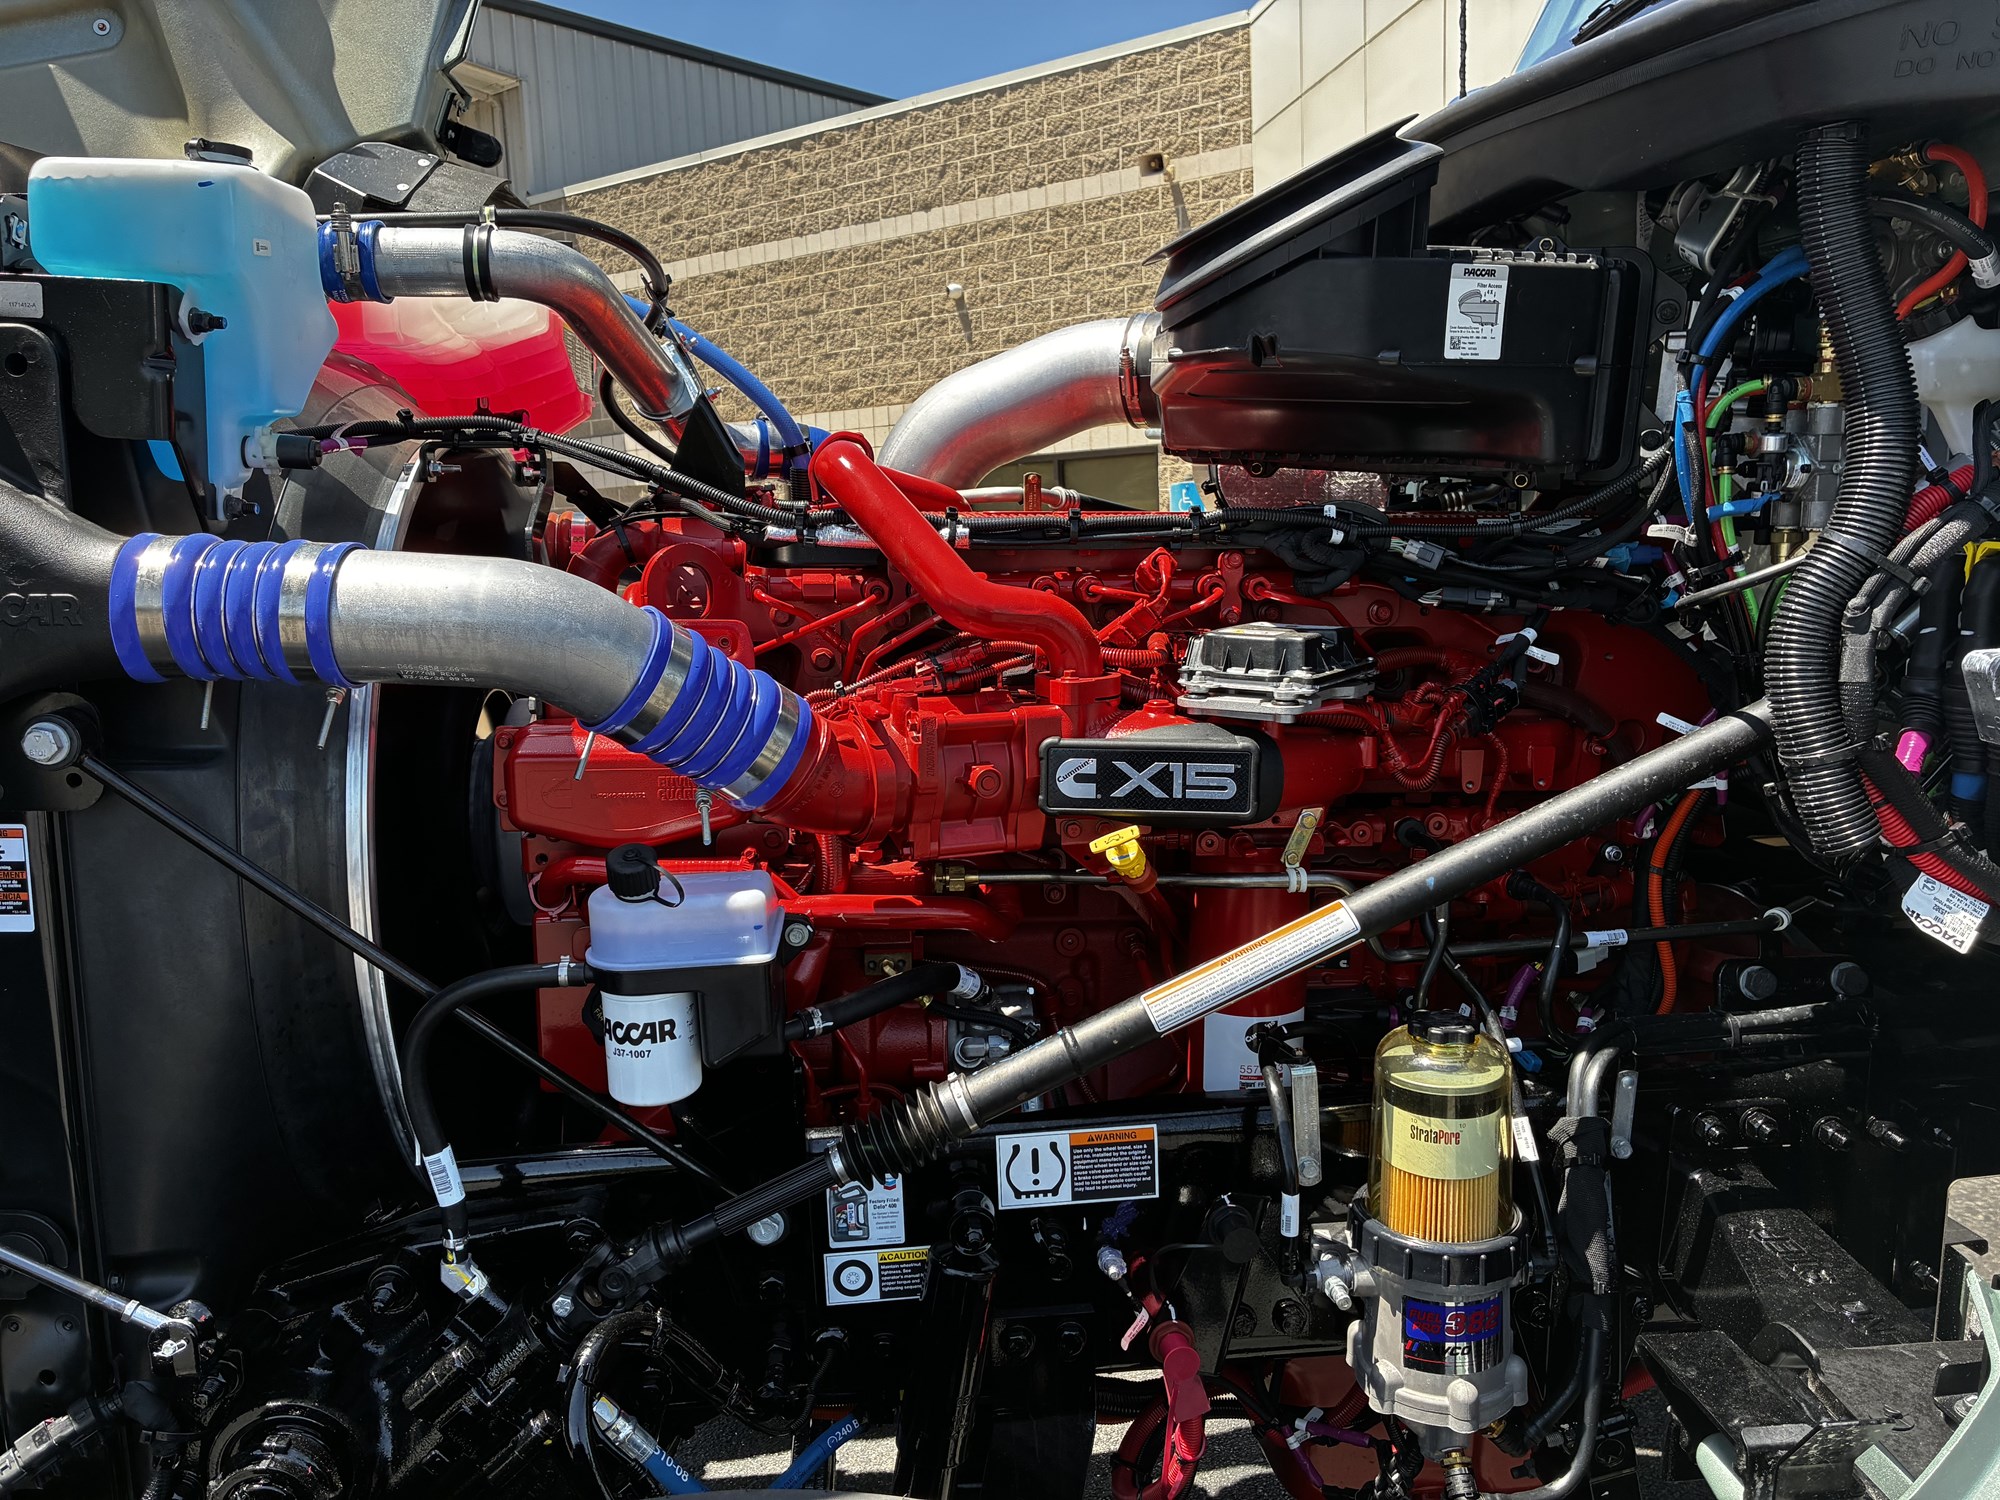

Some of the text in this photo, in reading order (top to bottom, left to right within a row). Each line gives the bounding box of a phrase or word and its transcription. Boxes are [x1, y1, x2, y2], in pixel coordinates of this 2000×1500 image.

[1899, 20, 1960, 50] NO
[1894, 49, 2000, 78] DO NO
[1464, 268, 1496, 278] PACCAR
[1057, 758, 1237, 800] Cummins X15
[1902, 905, 1965, 949] PACCAR
[1224, 938, 1268, 964] WARNING
[604, 1017, 677, 1046] ACCAR
[613, 1047, 652, 1058] J37-1007
[1096, 1131, 1137, 1142] WARNING
[1410, 1124, 1460, 1146] StrataPore
[1098, 1155, 1131, 1163] manufacturer.
[887, 1250, 928, 1260] CAUTION
[1409, 1304, 1500, 1337] FUEL 382
[1412, 1322, 1440, 1335] PRO
[834, 1423, 852, 1442] 240
